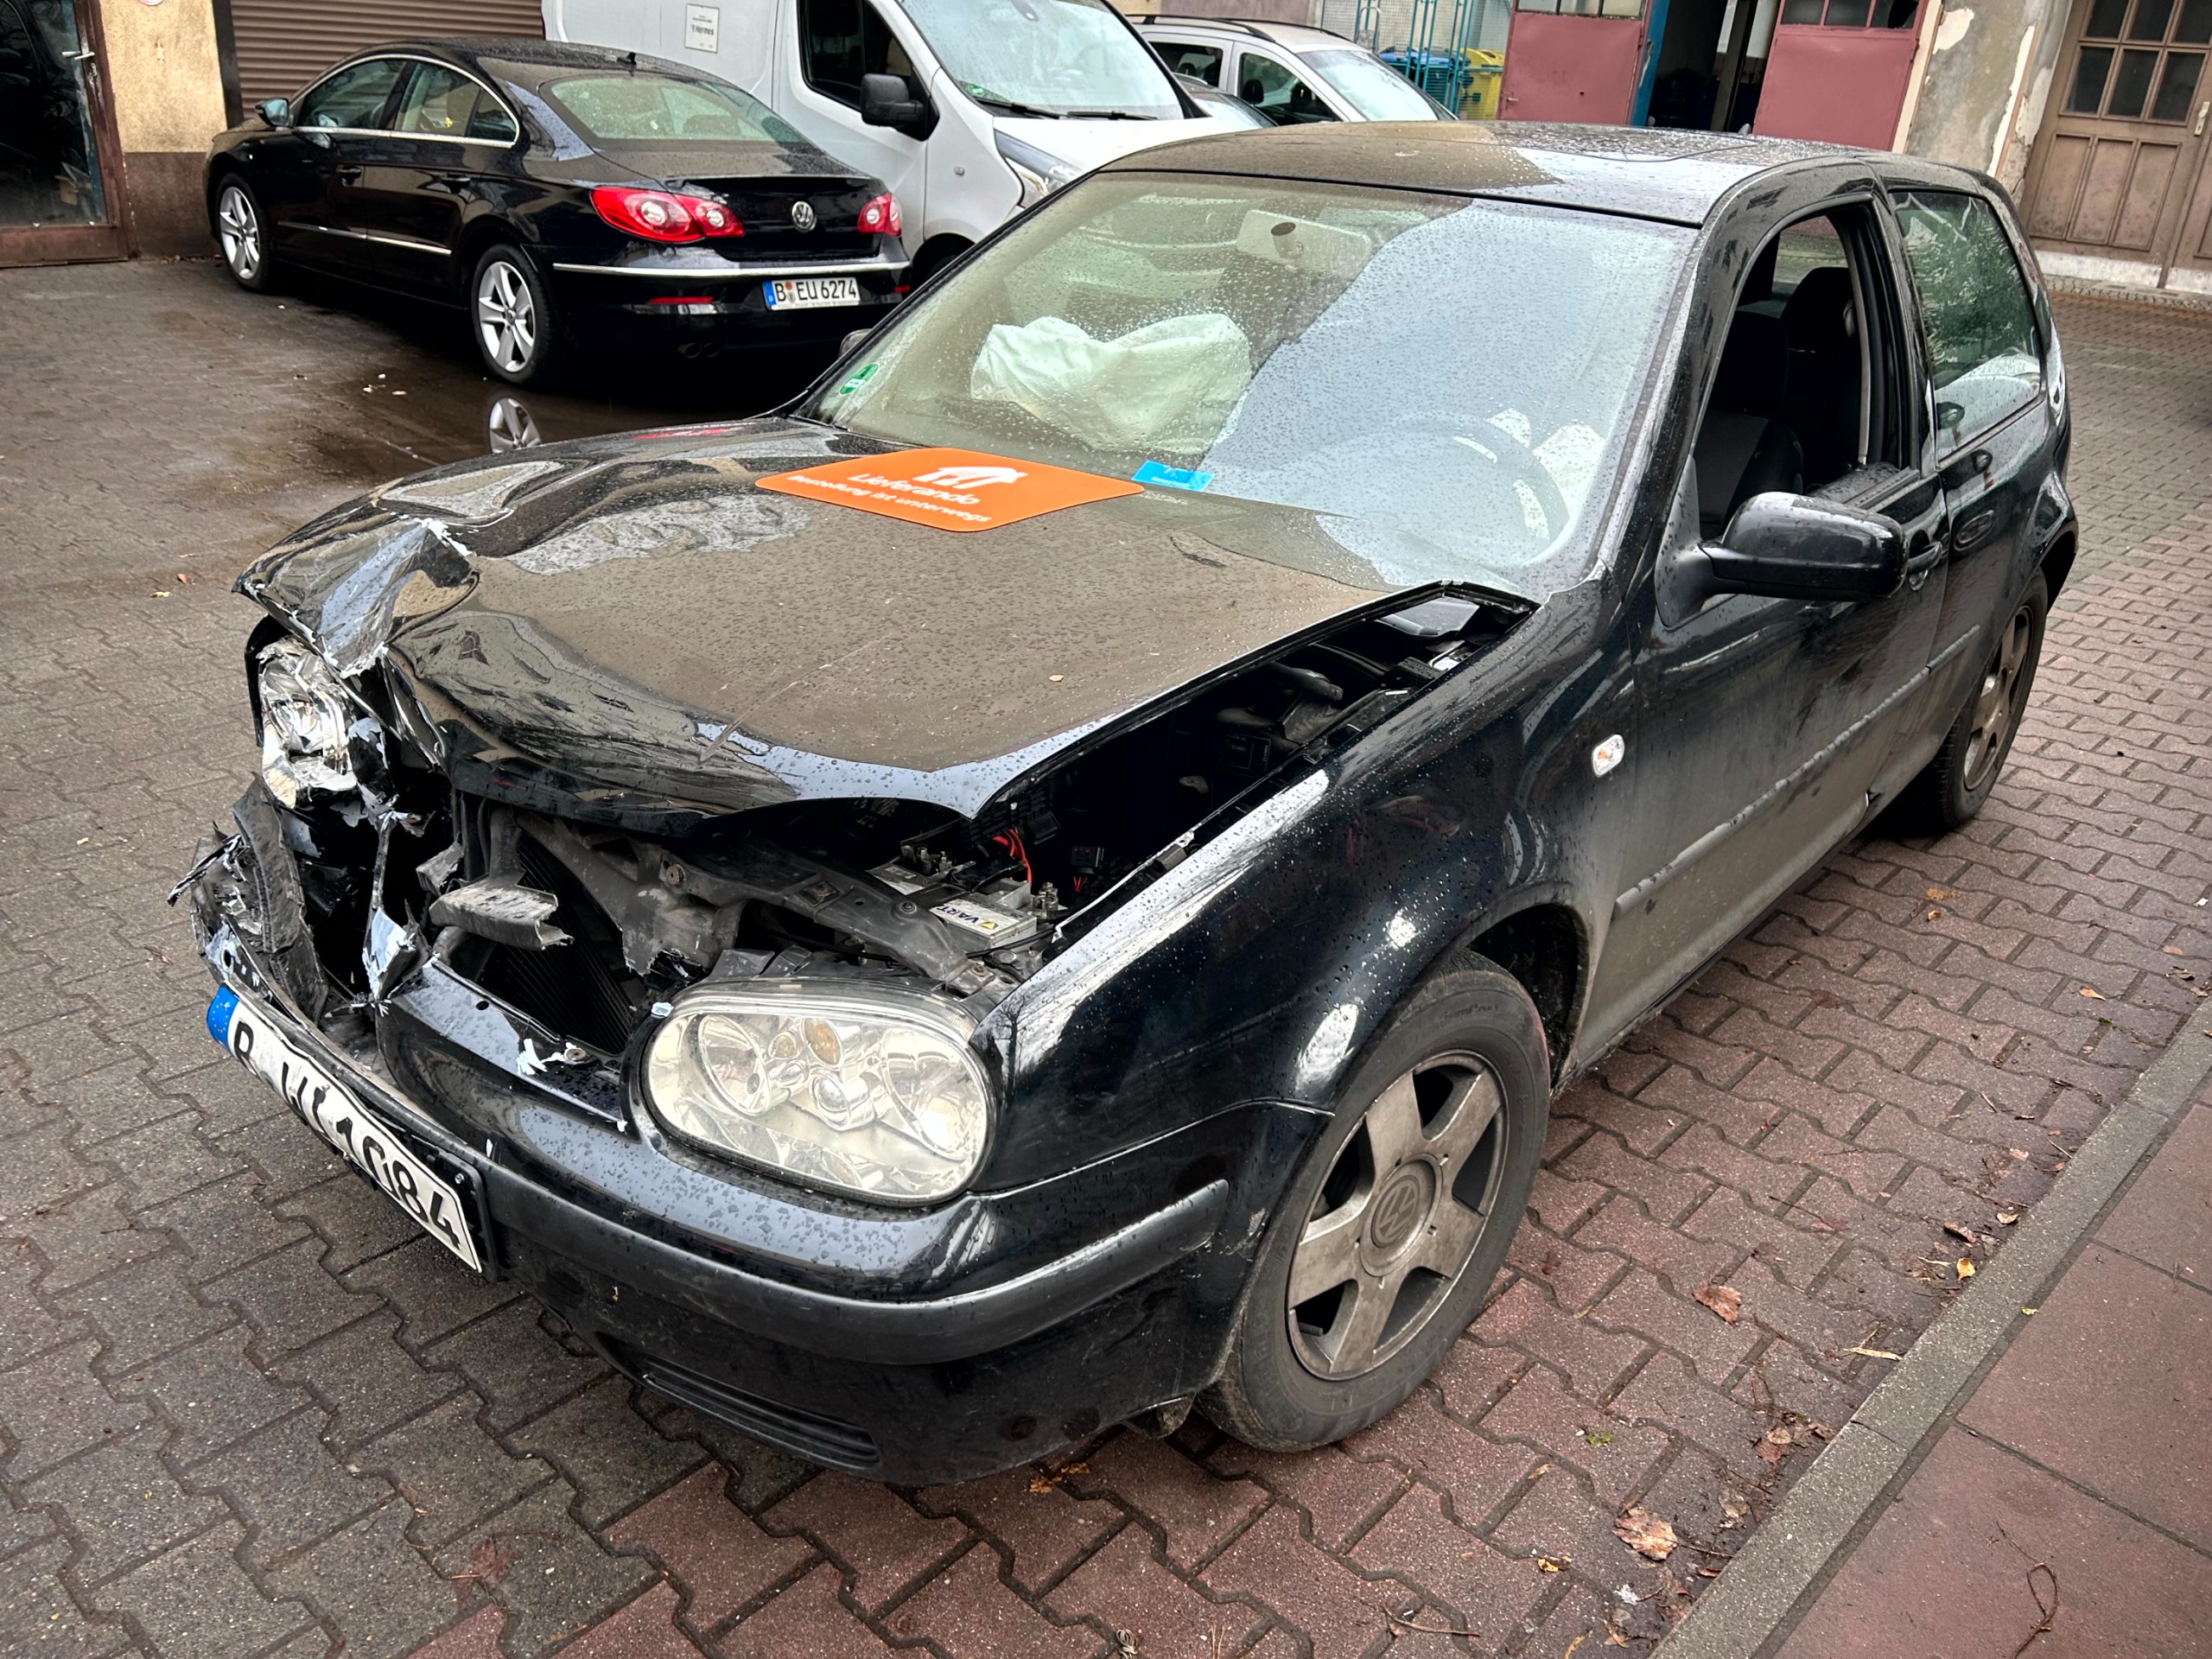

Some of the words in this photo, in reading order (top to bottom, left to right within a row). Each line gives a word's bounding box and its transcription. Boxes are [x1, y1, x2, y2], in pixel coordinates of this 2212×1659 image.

[696, 25, 714, 35] Hermes
[774, 283, 786, 302] B
[796, 281, 818, 301] EU
[821, 279, 856, 299] 6274
[786, 474, 874, 496] Bestellung
[870, 492, 897, 501] ist
[895, 497, 993, 522] unterwegs
[848, 474, 981, 505] Lieferando
[937, 904, 979, 923] VART
